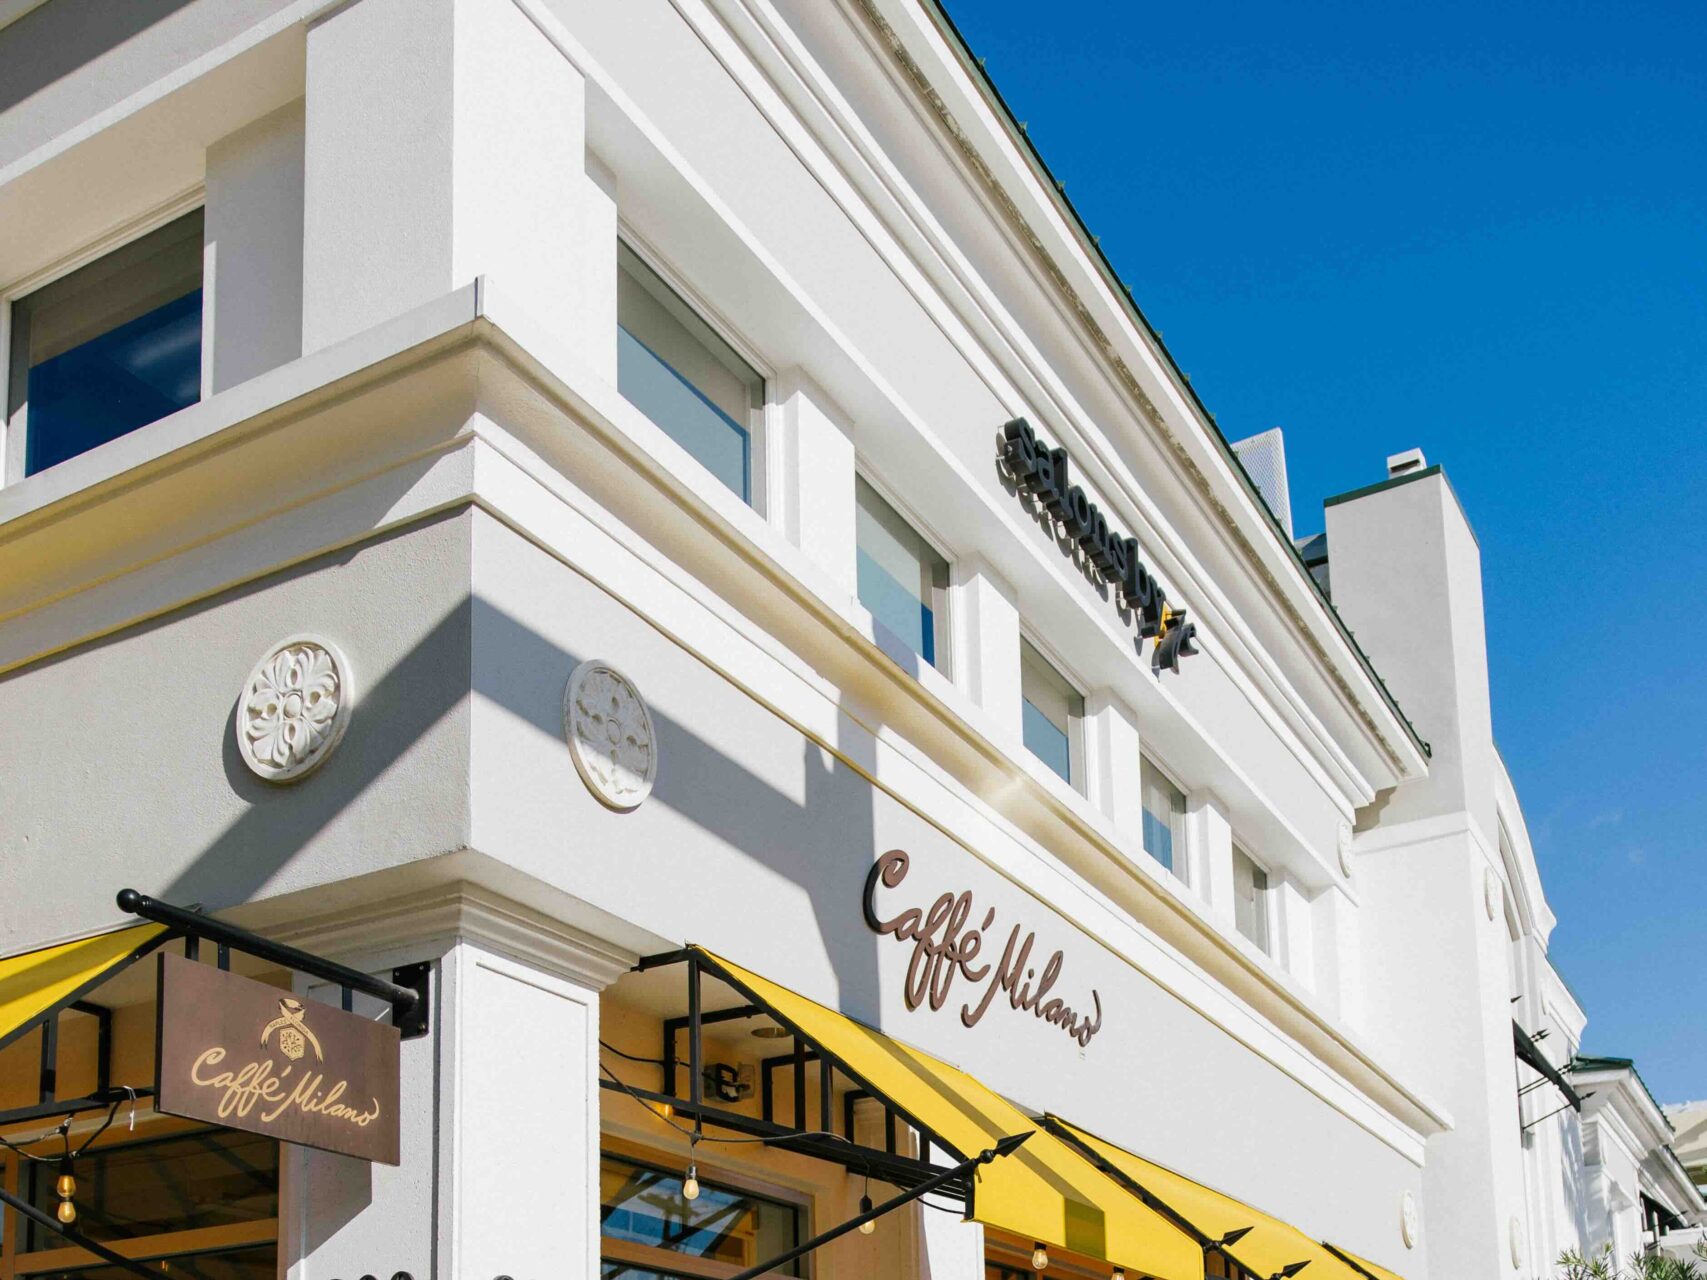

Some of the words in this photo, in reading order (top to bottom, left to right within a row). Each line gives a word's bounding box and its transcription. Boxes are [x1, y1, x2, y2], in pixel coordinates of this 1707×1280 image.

[863, 849, 995, 1012] Caffé
[961, 923, 1102, 1048] Milano
[191, 1047, 292, 1118] Caffé
[261, 1071, 379, 1127] Milano
